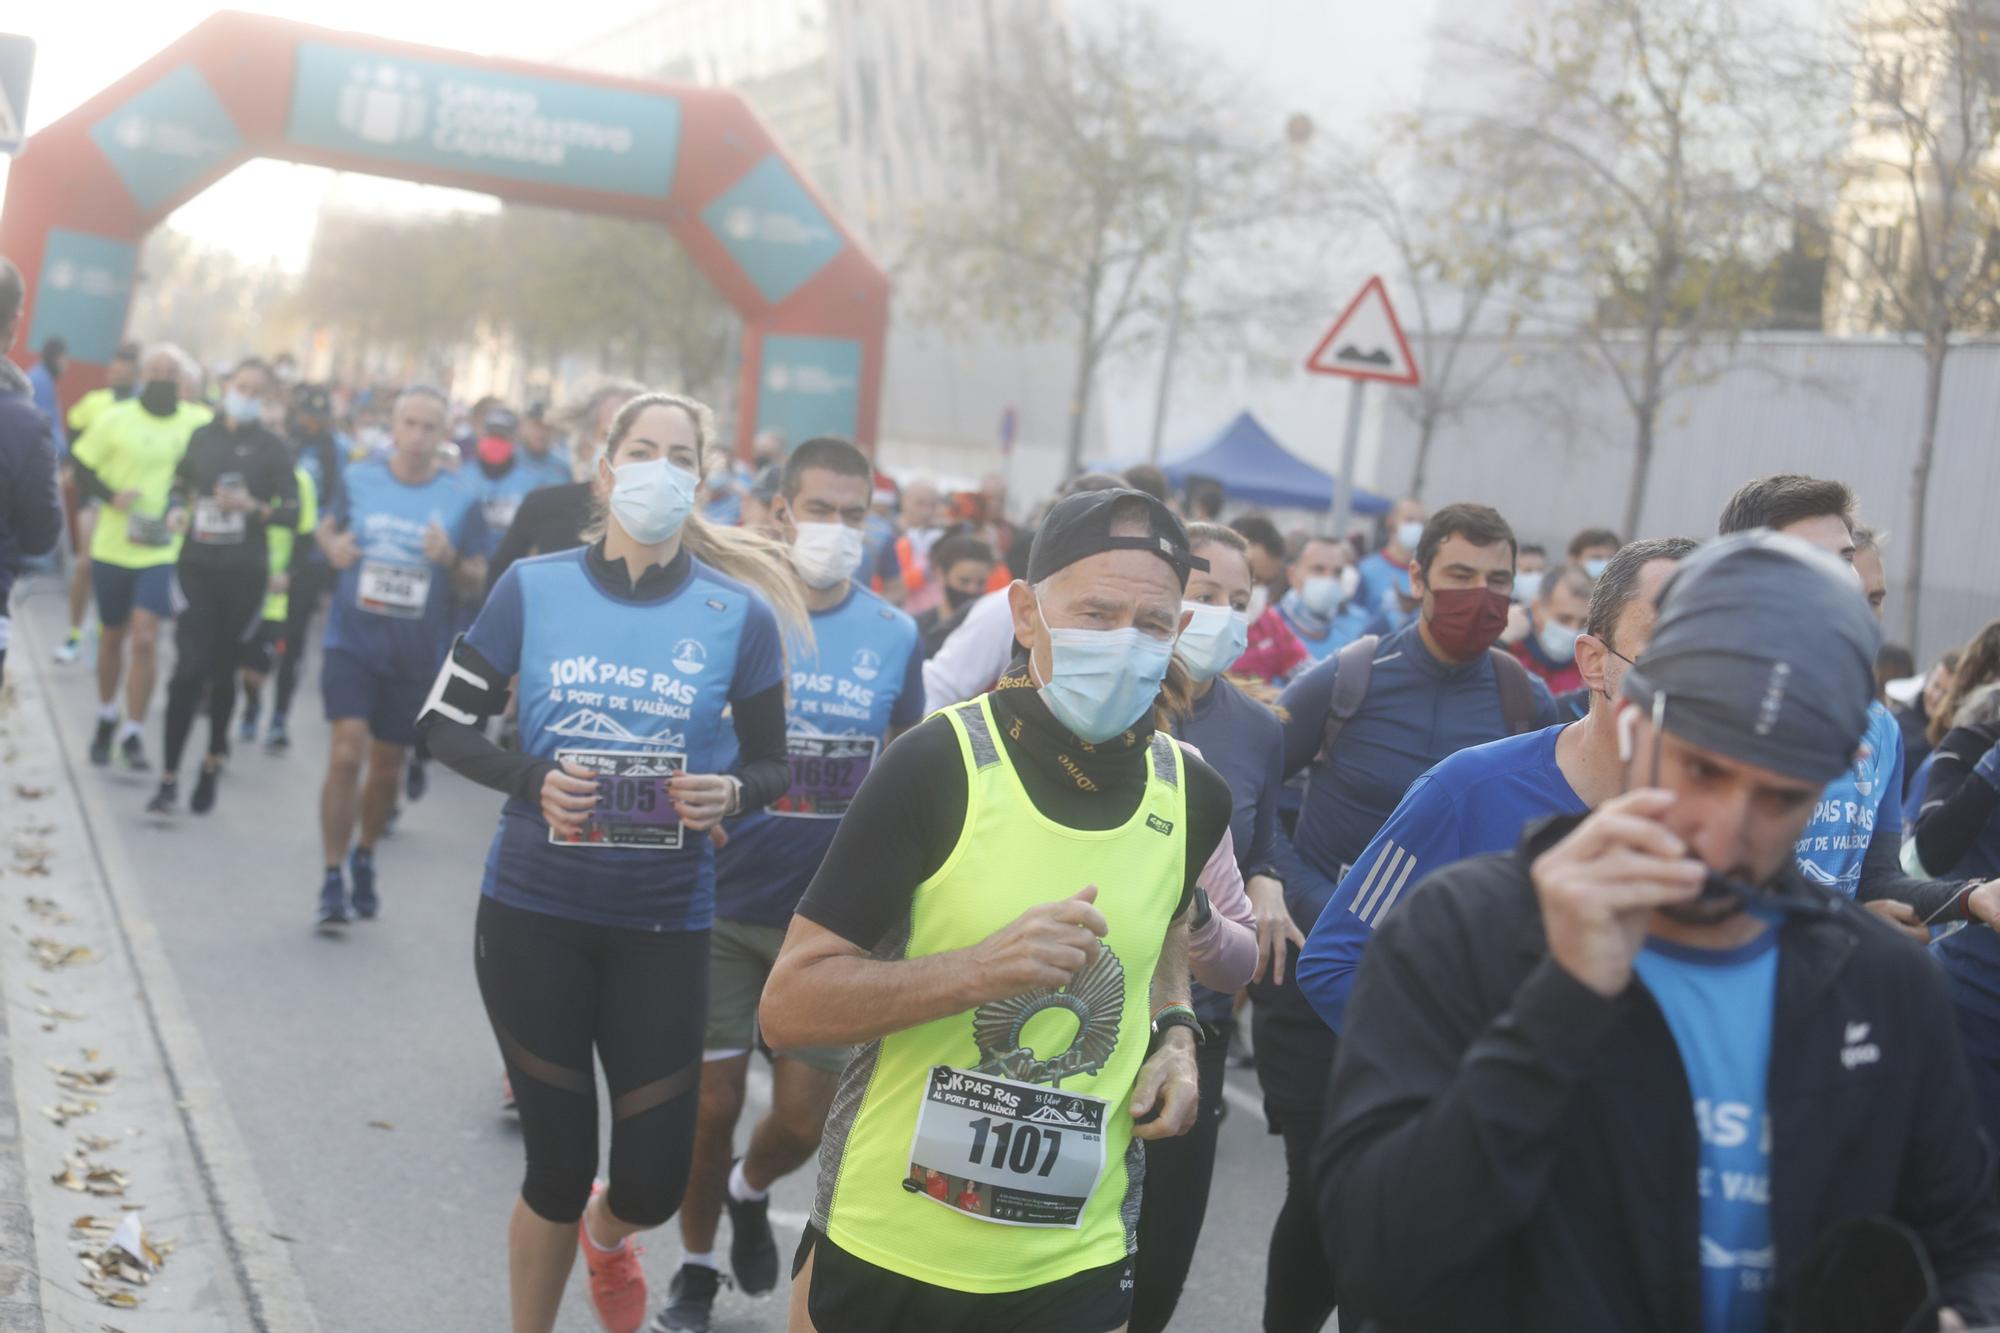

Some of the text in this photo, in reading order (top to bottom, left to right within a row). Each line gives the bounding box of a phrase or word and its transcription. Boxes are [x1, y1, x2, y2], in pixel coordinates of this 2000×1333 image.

[549, 656, 697, 705] 10K PAS RAS
[791, 672, 875, 707] PAS RAS
[549, 688, 691, 720] AL PORT DE VALÈNCIA
[793, 756, 854, 788] 1692
[1812, 800, 1874, 832] PAS RAS
[1815, 836, 1828, 851] DE
[1833, 829, 1872, 851] VALÈNCI
[932, 1091, 1016, 1117] AL PORT DE VALÈNCIA
[964, 1080, 992, 1097] PAS
[994, 1088, 1021, 1108] RAS
[968, 1116, 1062, 1178] 1107
